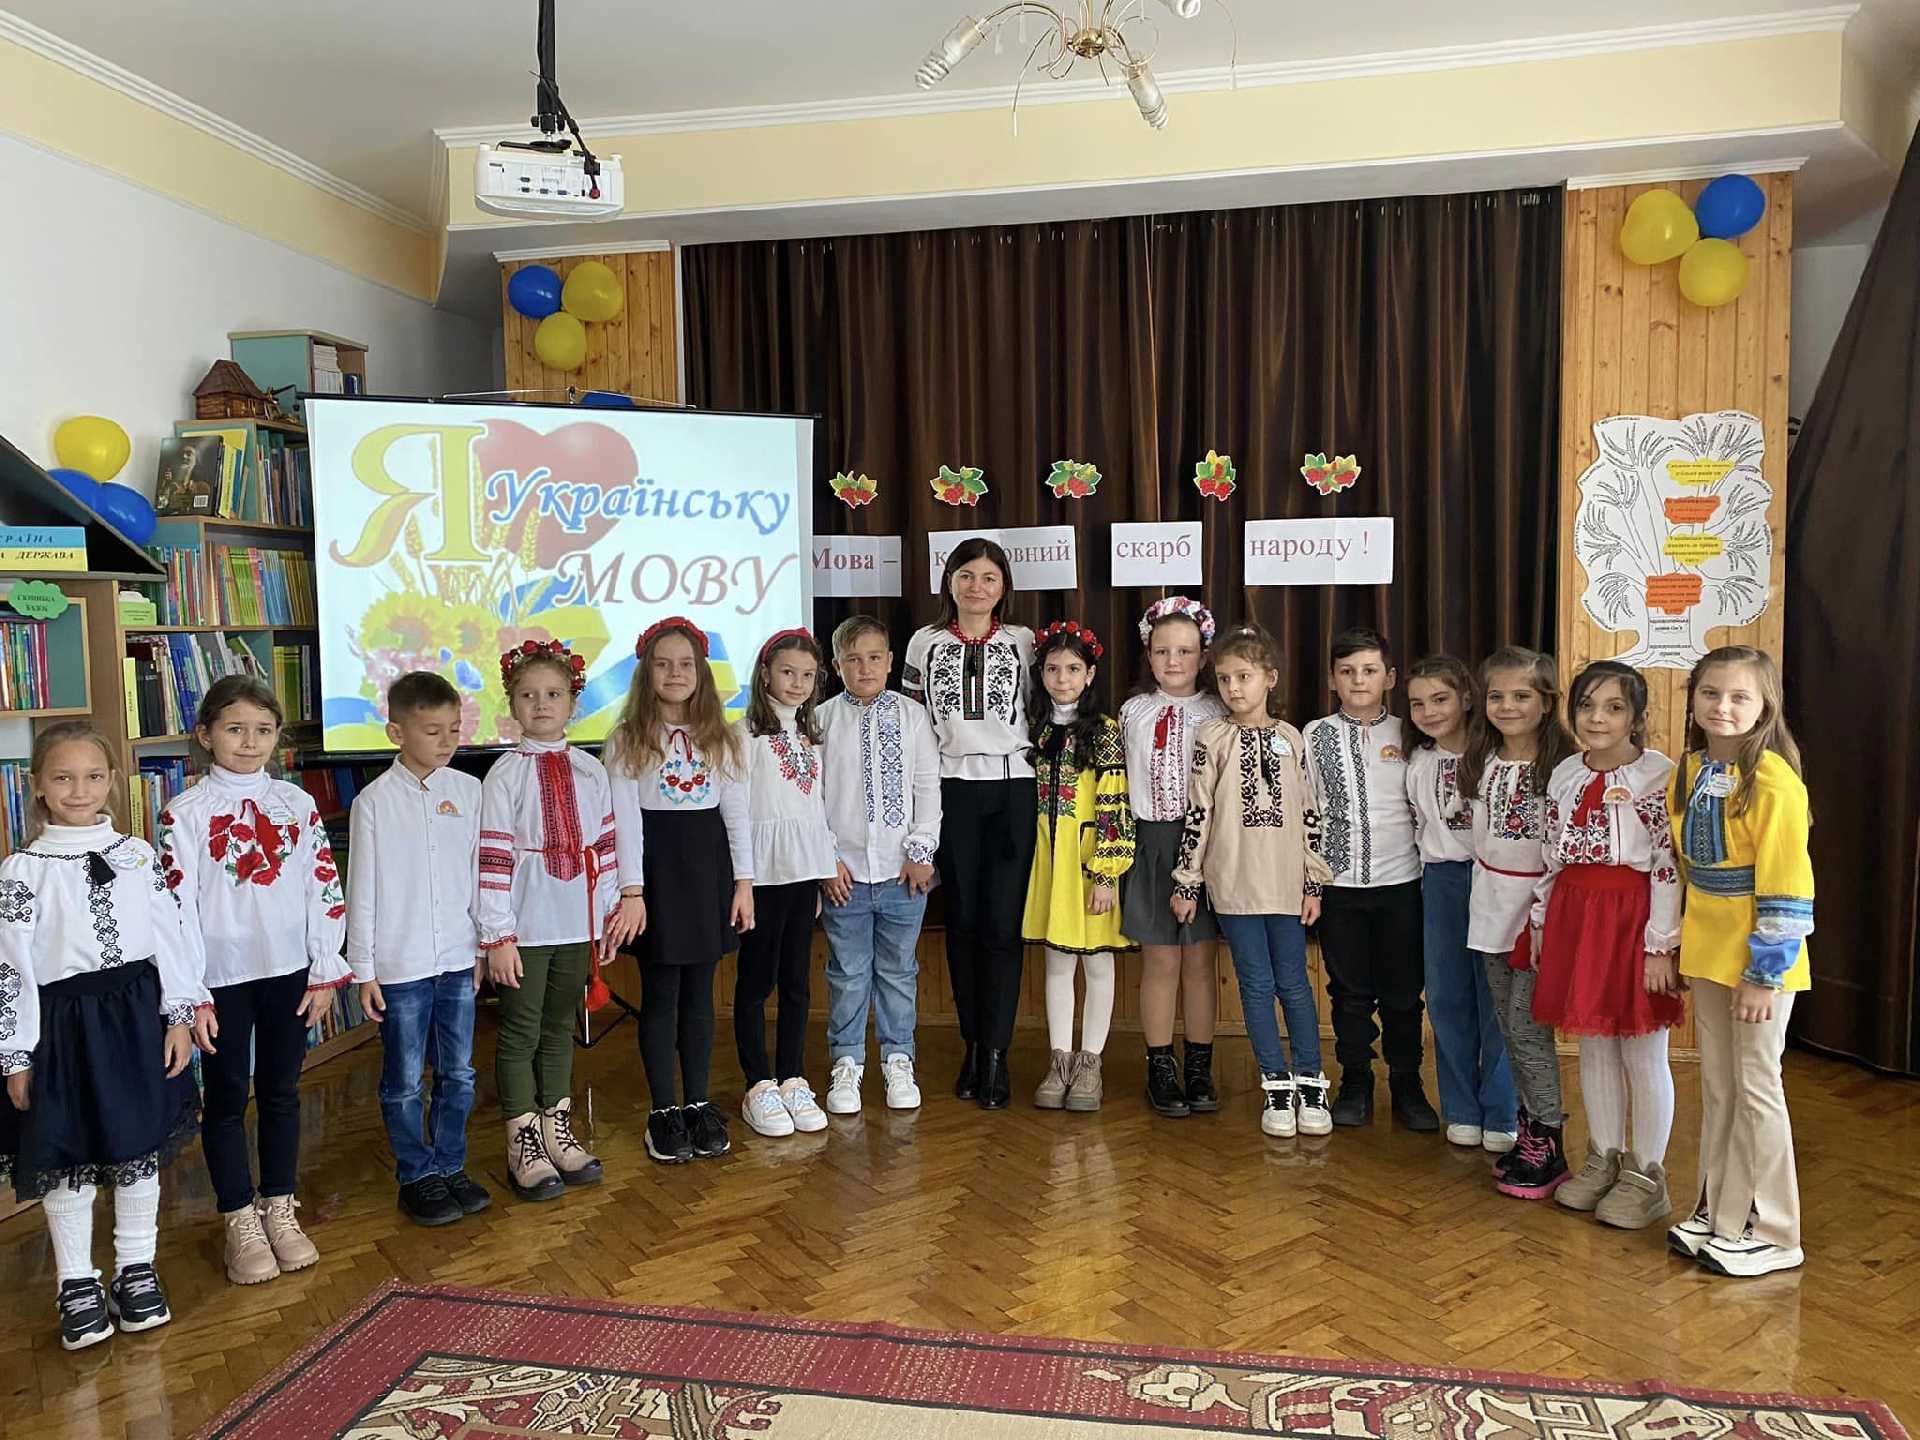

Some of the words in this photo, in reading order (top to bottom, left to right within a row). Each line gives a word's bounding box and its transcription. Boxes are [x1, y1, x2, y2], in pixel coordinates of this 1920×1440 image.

[329, 423, 492, 568] Я
[487, 469, 790, 535] Українську
[15, 551, 74, 560] ДЕРЖАВА
[1116, 534, 1191, 564] скарб
[1250, 537, 1352, 562] народу
[554, 551, 799, 616] МОВУ
